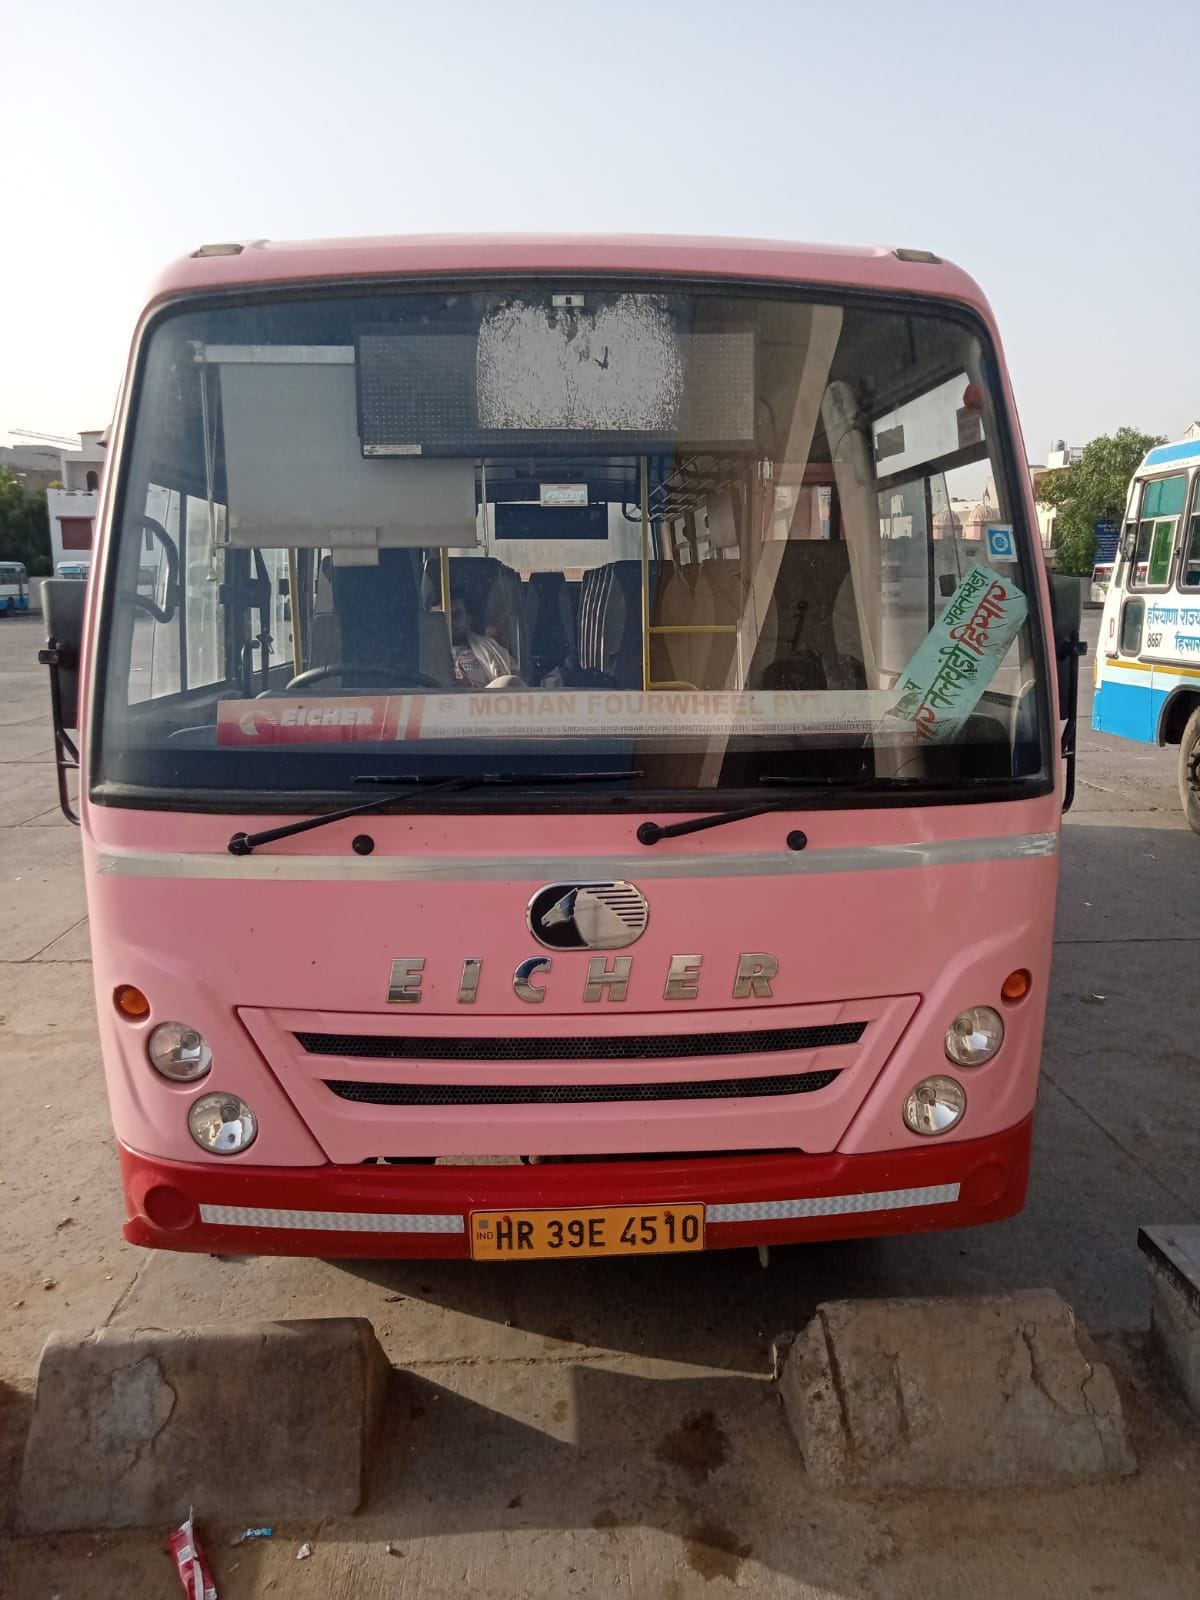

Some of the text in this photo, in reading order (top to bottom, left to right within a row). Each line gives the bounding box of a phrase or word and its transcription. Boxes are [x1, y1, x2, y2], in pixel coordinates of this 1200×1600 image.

[949, 580, 1010, 656] हिसार
[1146, 602, 1178, 629] हरियाणा
[280, 706, 374, 728] EICHER
[470, 694, 577, 717] MOHAN
[587, 693, 763, 716] FOURWHEEL
[385, 952, 779, 1004] EICHER
[475, 1213, 700, 1250] IND HR 39E 4510
